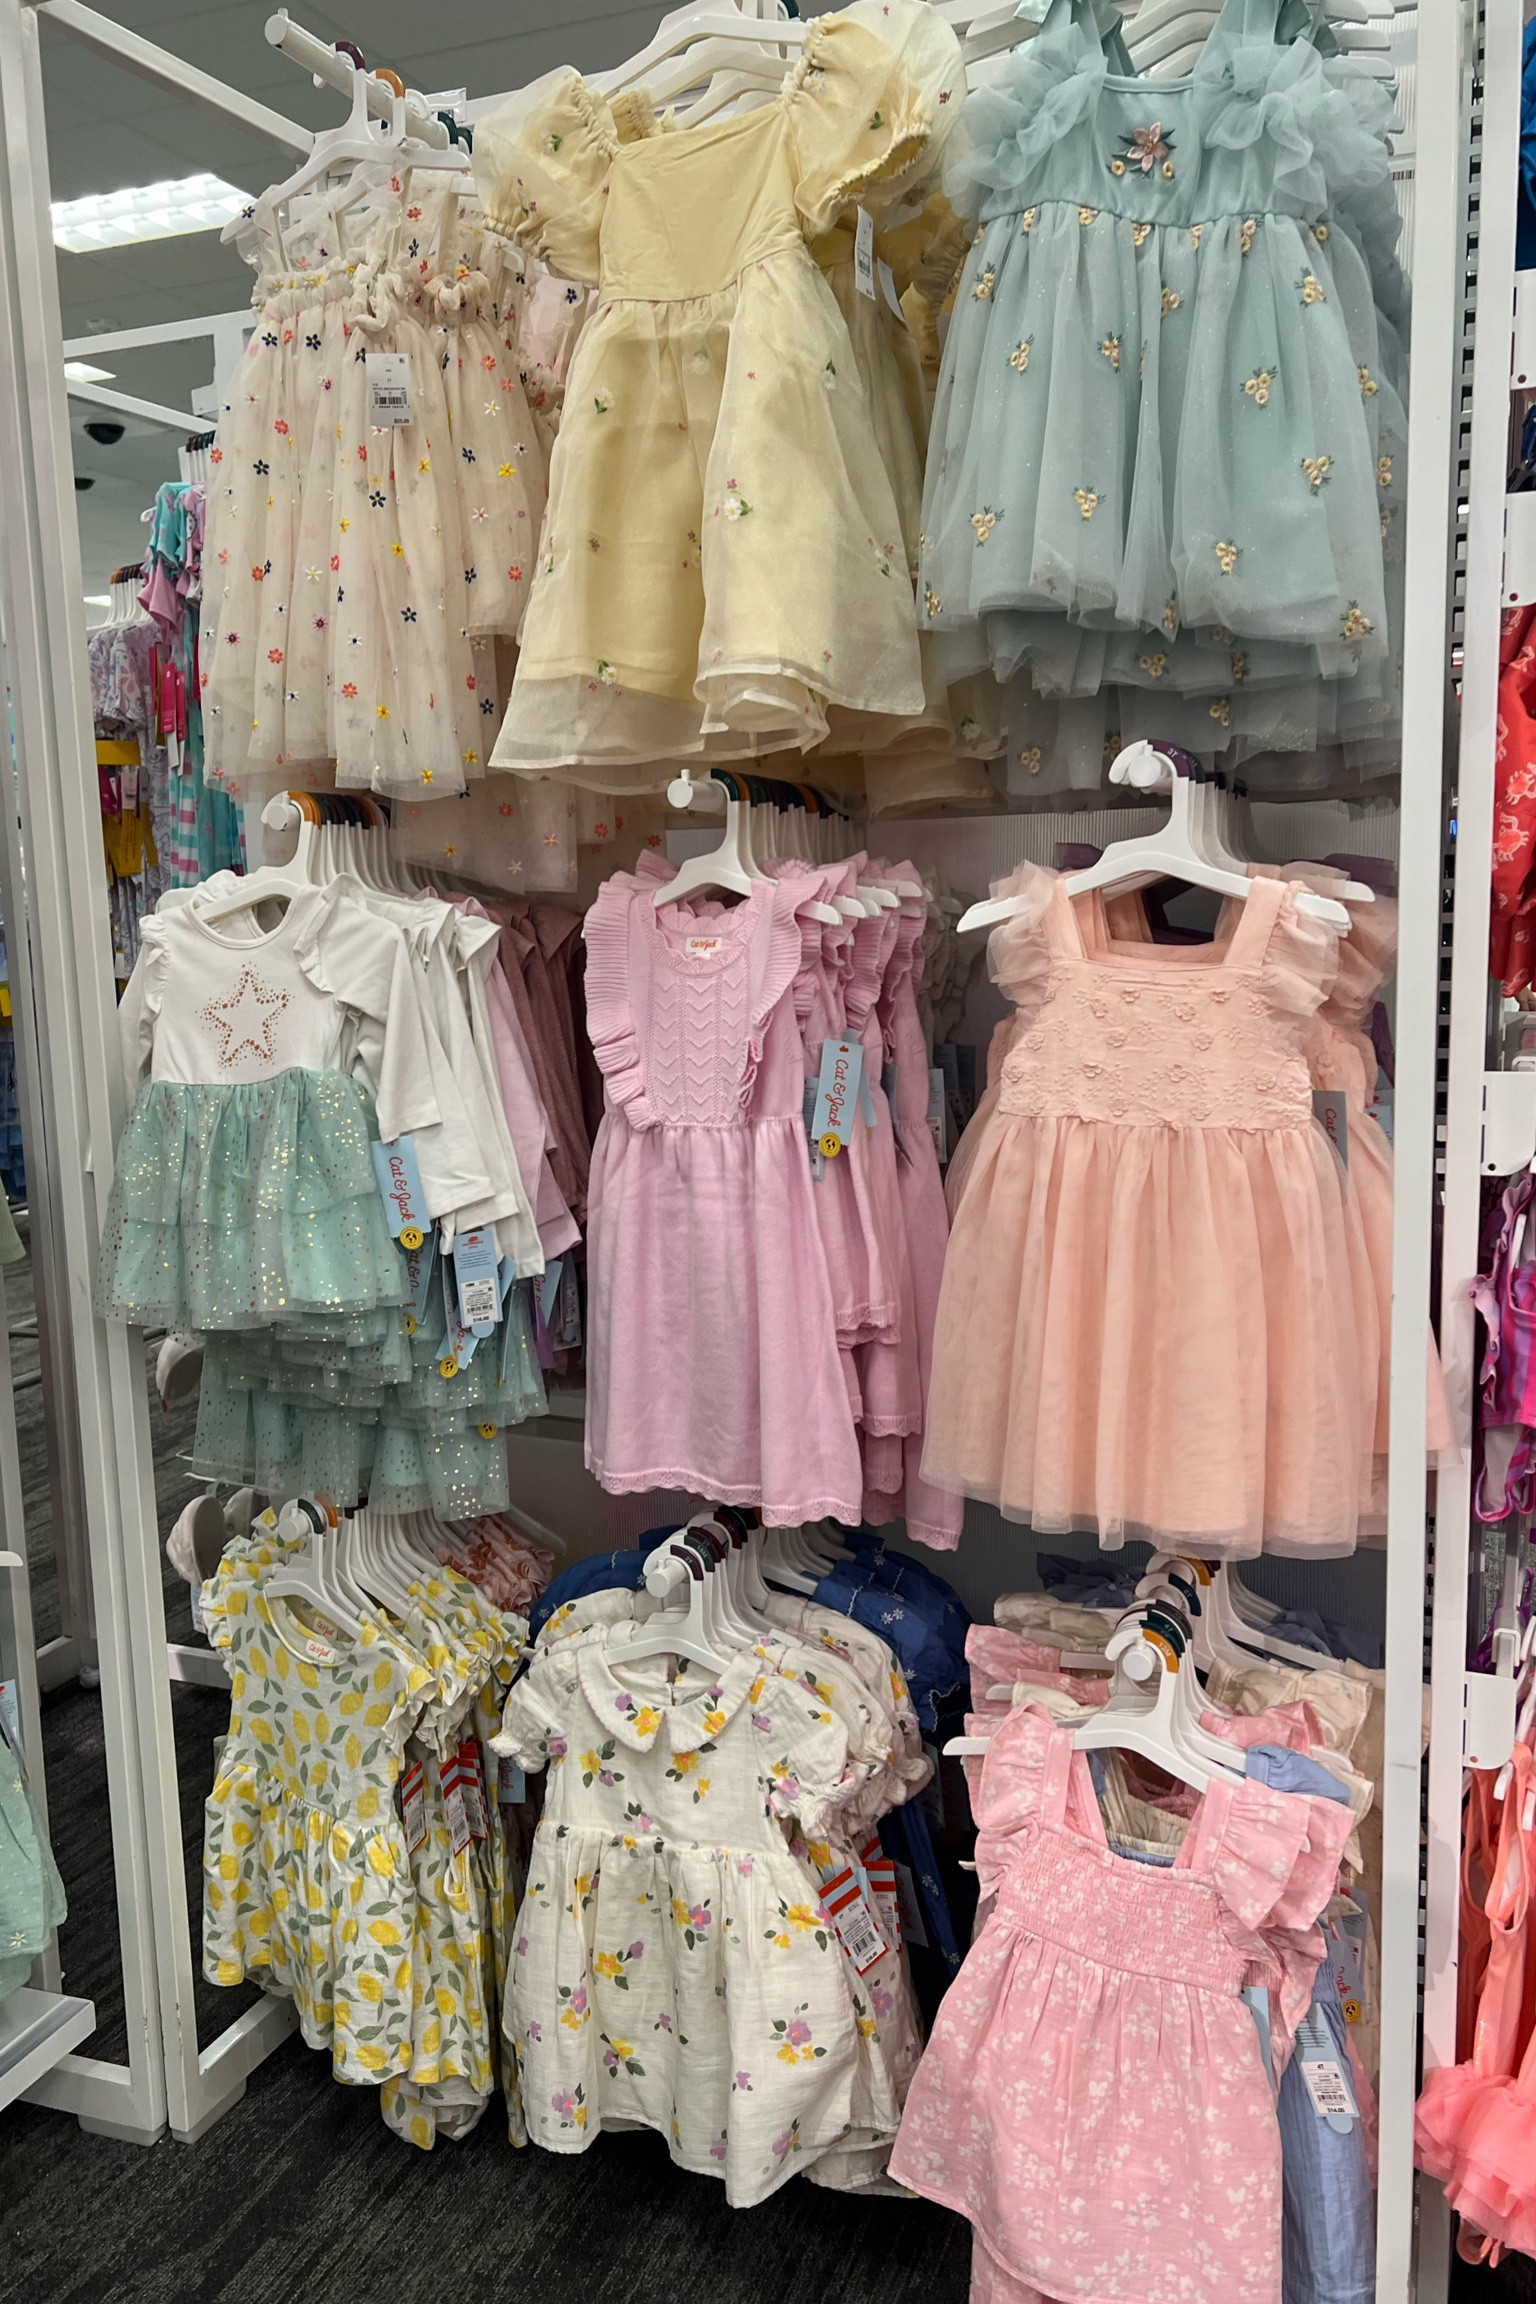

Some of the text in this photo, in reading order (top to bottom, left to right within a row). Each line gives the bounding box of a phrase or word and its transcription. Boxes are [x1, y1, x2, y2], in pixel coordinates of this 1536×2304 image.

[824, 1058, 849, 1128] Cat & Jack
[388, 1156, 416, 1222] Cat & Jack
[1159, 1641, 1172, 1657] 12M
